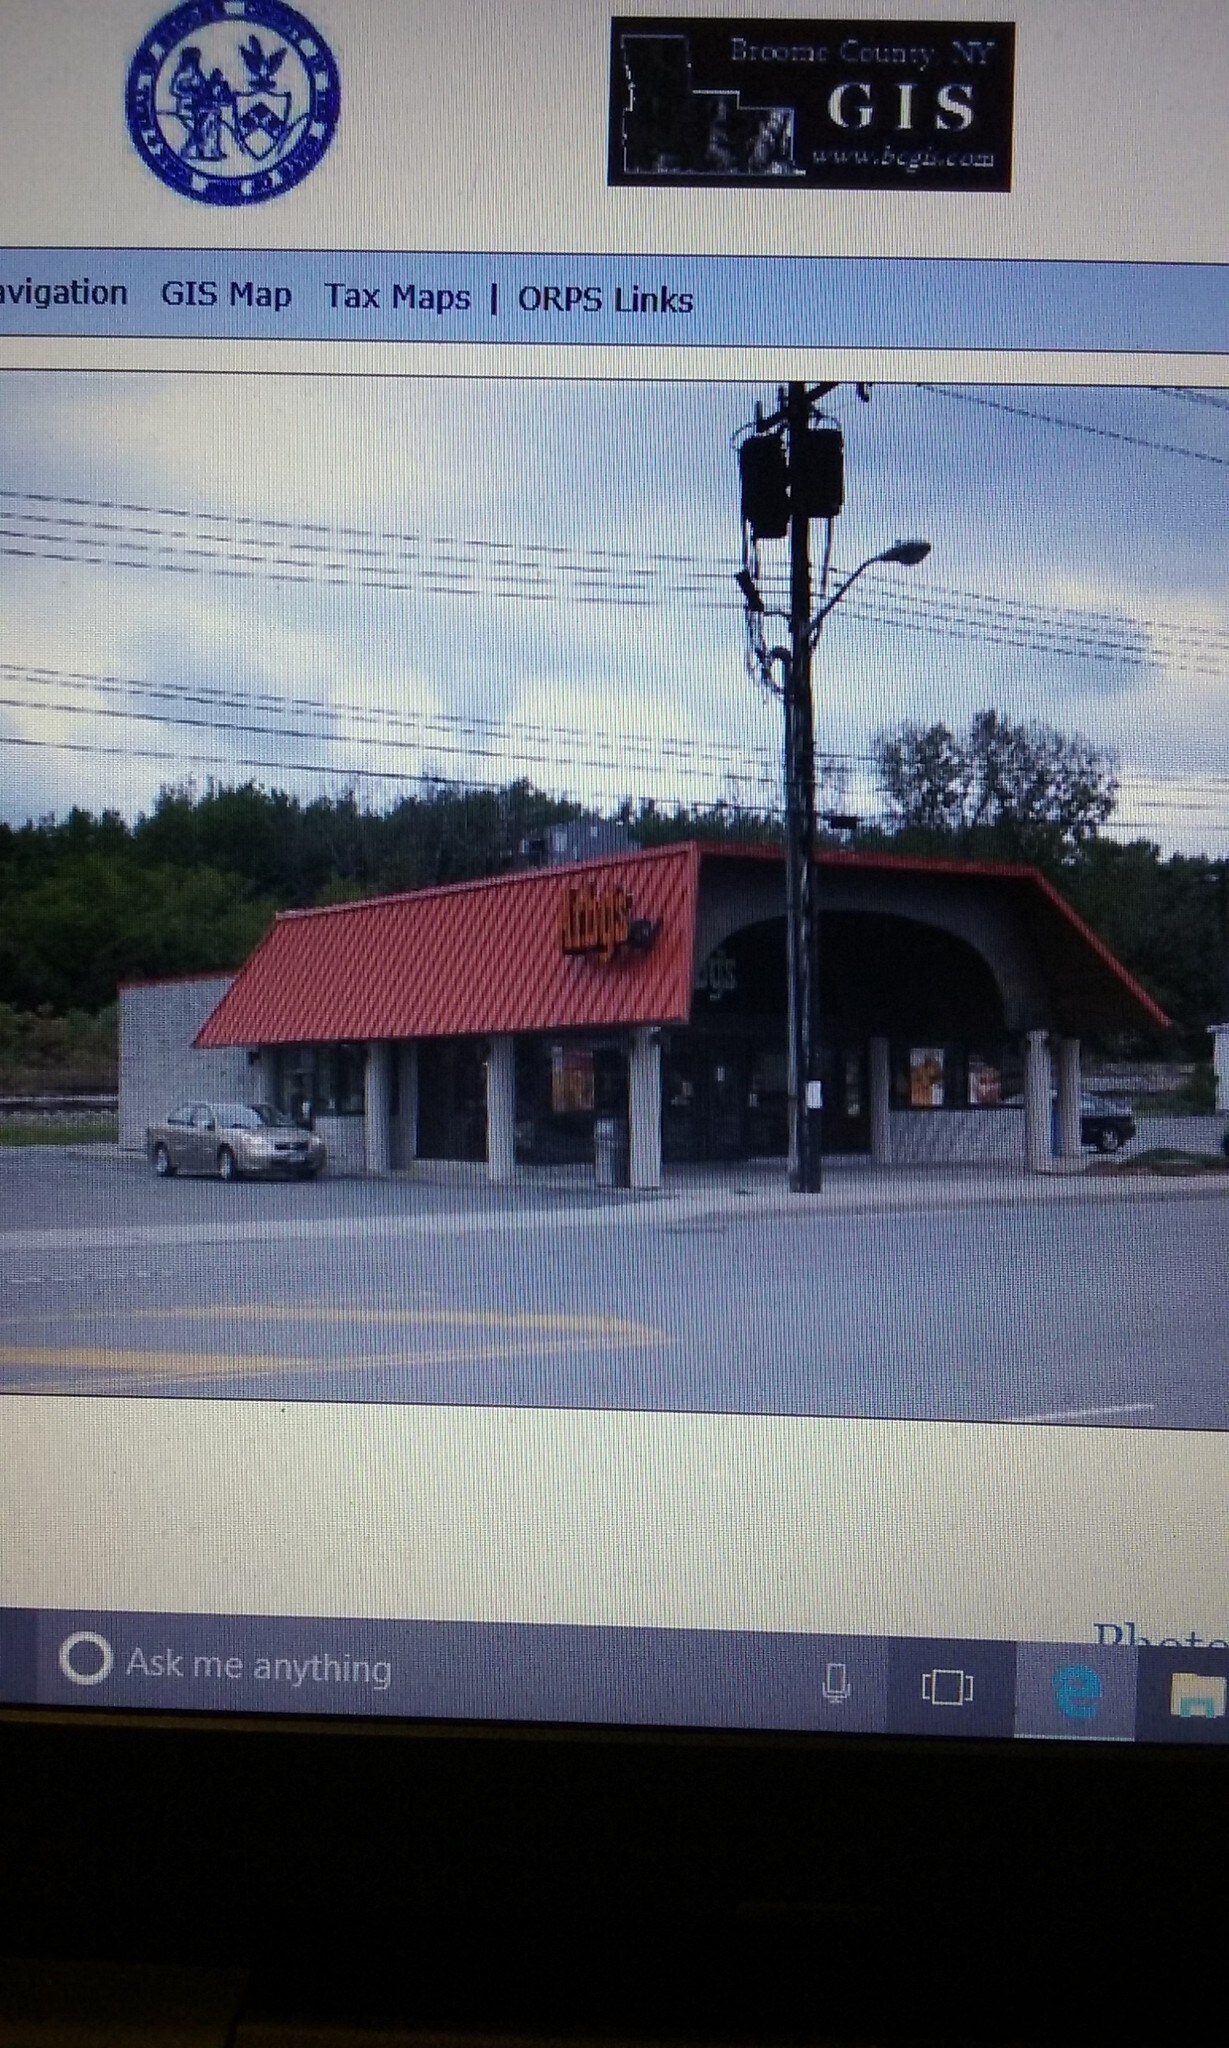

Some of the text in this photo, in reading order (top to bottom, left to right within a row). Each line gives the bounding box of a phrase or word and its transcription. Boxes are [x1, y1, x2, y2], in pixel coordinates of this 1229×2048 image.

[730, 38, 829, 62] Broome
[952, 41, 997, 64] NY
[162, 281, 292, 312] GIS Map
[324, 283, 471, 315] Tax Maps
[519, 284, 694, 313] ORPS Links
[126, 1647, 392, 1690] Ask me anything
